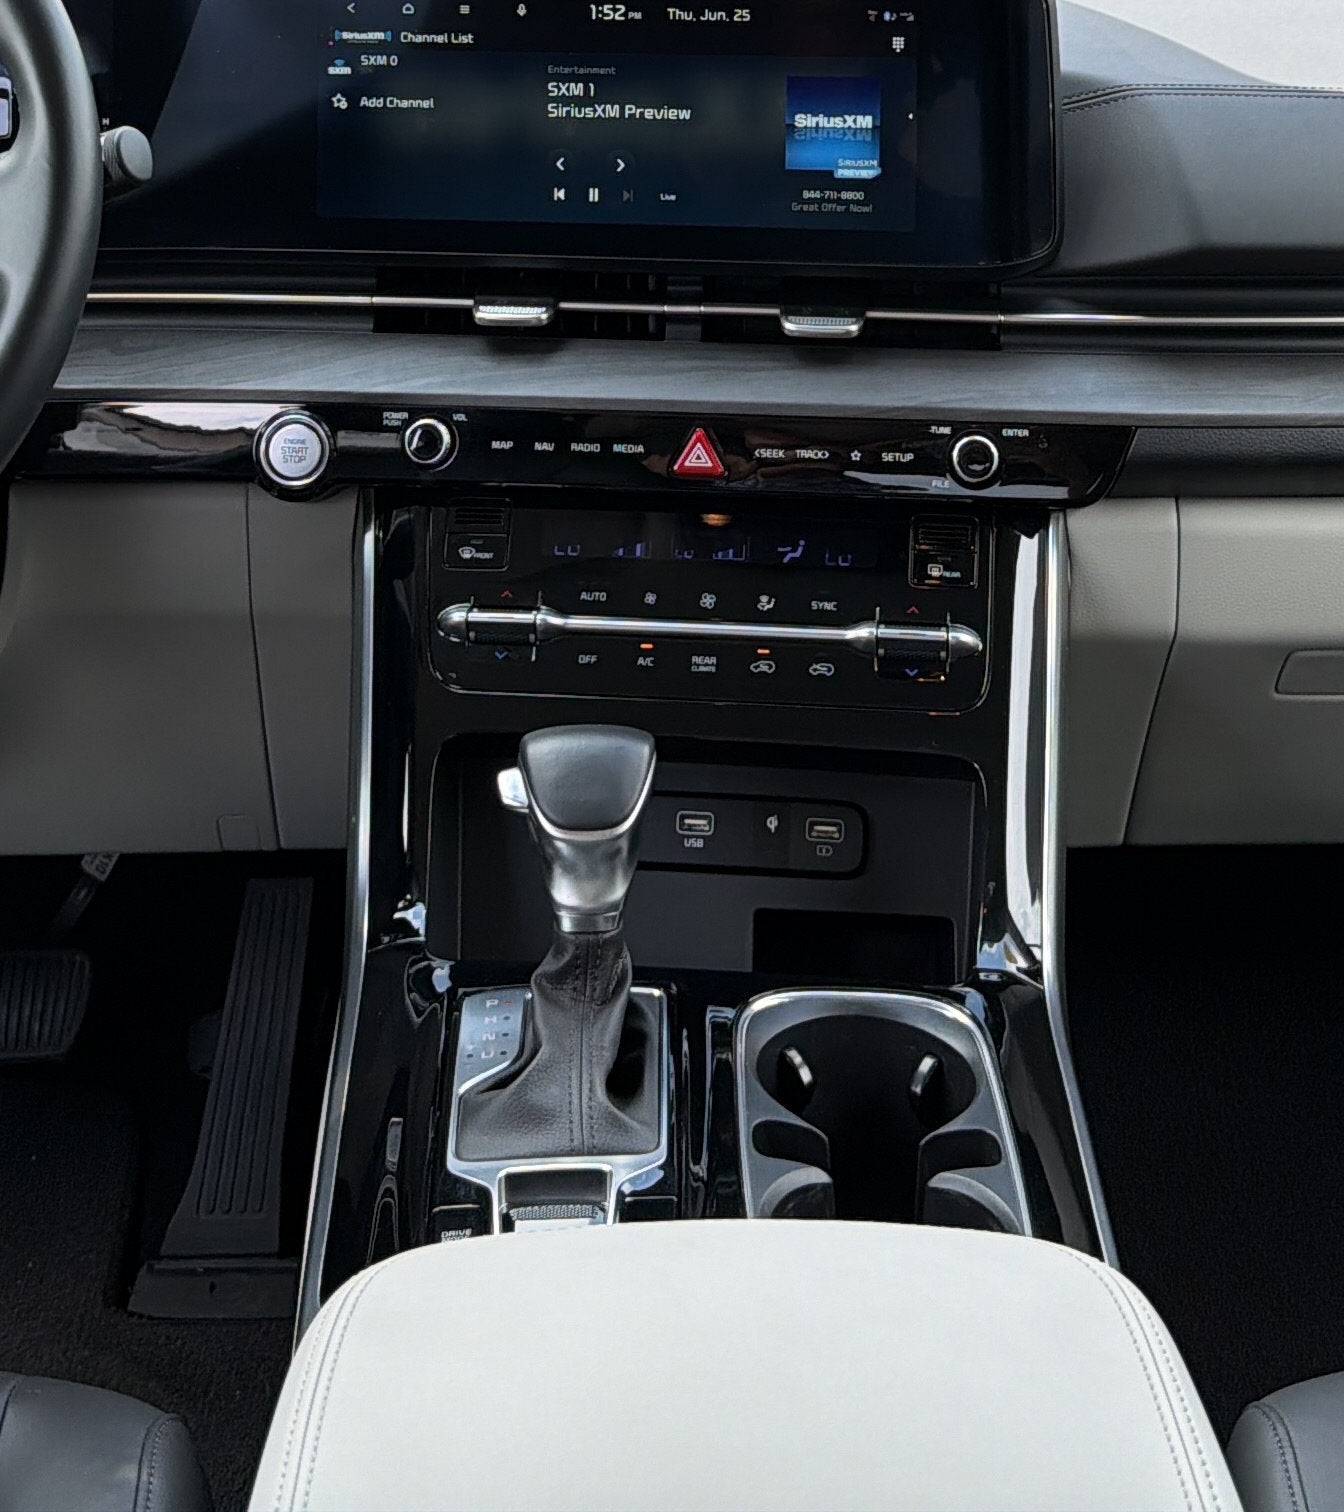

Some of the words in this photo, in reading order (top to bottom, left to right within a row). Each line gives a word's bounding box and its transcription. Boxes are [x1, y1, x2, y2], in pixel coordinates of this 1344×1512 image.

[589, 4, 626, 20] 1:52
[628, 12, 642, 20] PM
[733, 8, 751, 22] 25
[401, 32, 448, 44] Channel
[451, 32, 475, 44] List
[360, 54, 387, 66] SXM
[547, 65, 616, 76] Entertainment
[547, 81, 584, 97] SXM
[589, 82, 595, 97] 1
[360, 96, 383, 108] Add
[386, 96, 434, 109] Channel
[547, 103, 620, 119] SiriusXM
[624, 104, 692, 120] Preview
[794, 113, 873, 129] SiriusXM
[802, 190, 865, 200] 844-711-8800
[791, 202, 819, 212] Great
[821, 202, 847, 212] Offer
[849, 203, 873, 213] Now!
[452, 412, 468, 422] VOL
[382, 419, 402, 427] PUSH
[930, 425, 952, 435] TUNE
[1002, 428, 1029, 437] ENTER
[283, 437, 307, 445] ENGINE
[491, 440, 514, 450] MAP
[534, 441, 555, 451] NAV
[280, 446, 310, 455] START
[570, 442, 601, 453] RADIO
[612, 443, 645, 454] MEDIA
[282, 454, 307, 464] STOP
[881, 452, 914, 462] SETUP
[580, 591, 607, 601] AUTO
[811, 600, 837, 611] SYNC
[578, 654, 598, 664] OFF
[637, 656, 655, 667] A/C
[692, 655, 717, 664] REAR
[684, 838, 704, 848] USB
[486, 999, 499, 1008] P
[441, 1228, 472, 1239] DRIVE
